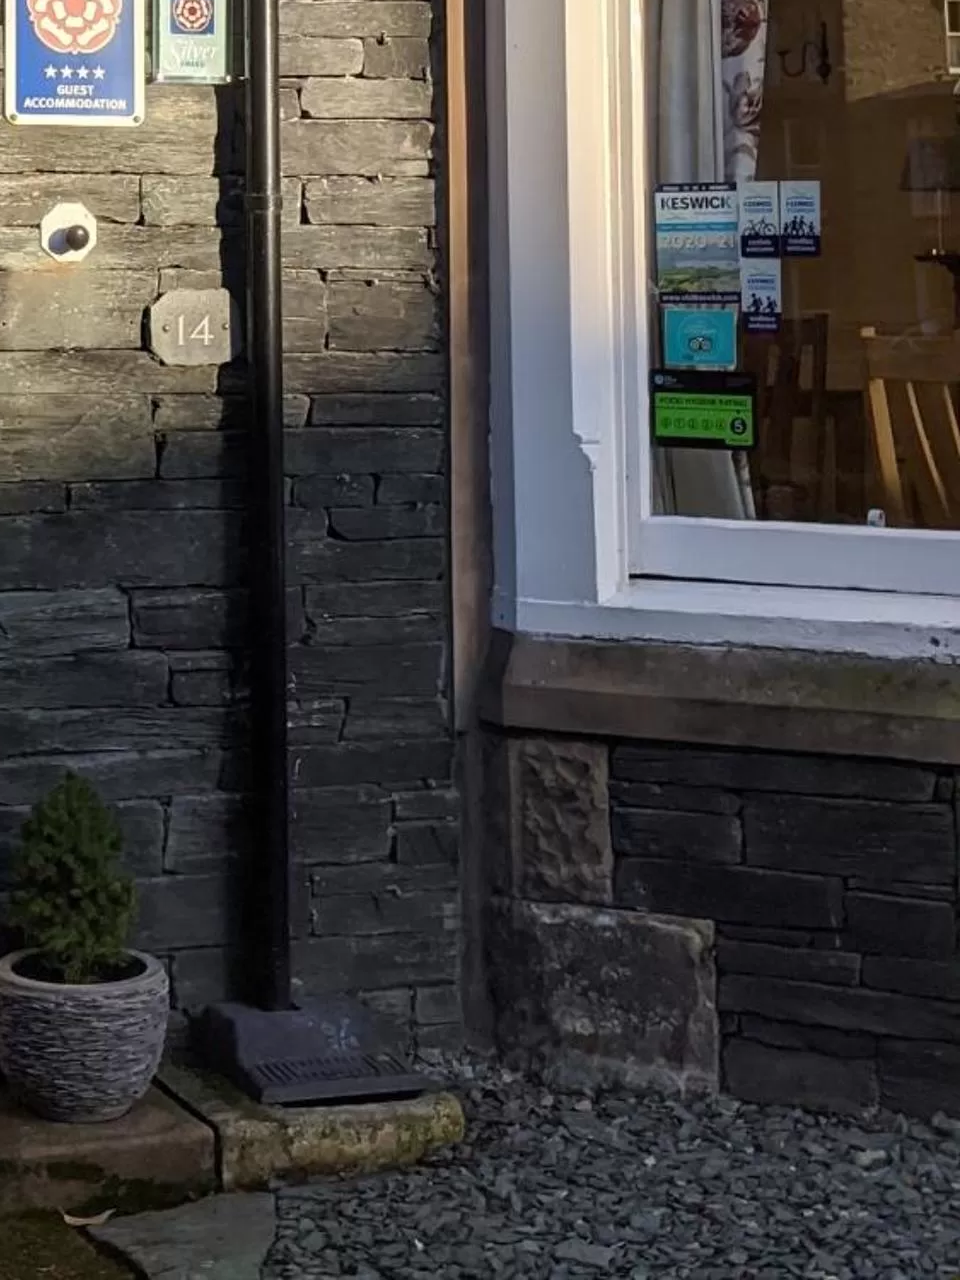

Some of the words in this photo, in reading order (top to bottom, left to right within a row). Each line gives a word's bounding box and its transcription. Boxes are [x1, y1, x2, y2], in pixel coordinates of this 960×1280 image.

[56, 84, 95, 95] GUEST
[23, 97, 127, 110] ACCOMMODATION
[660, 195, 732, 211] KESWICK
[176, 314, 215, 346] 14
